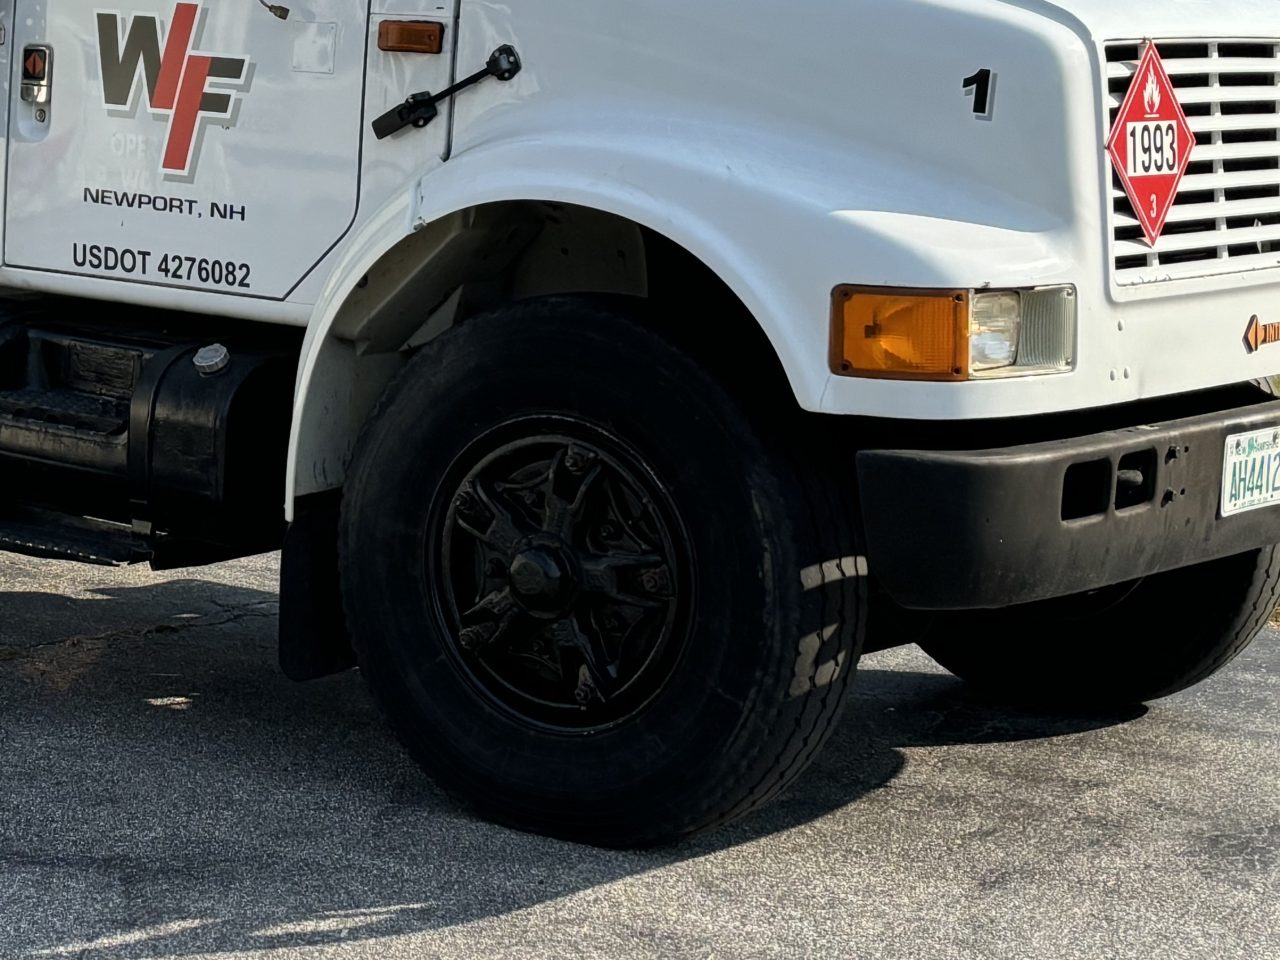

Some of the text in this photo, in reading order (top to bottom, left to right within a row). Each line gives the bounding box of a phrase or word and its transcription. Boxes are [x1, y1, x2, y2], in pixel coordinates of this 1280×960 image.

[962, 67, 992, 115] 1
[1129, 123, 1177, 174] 1993
[83, 187, 246, 222] NEWPORT, NH
[1149, 193, 1157, 218] 3
[73, 242, 251, 289] USDOT 4276082
